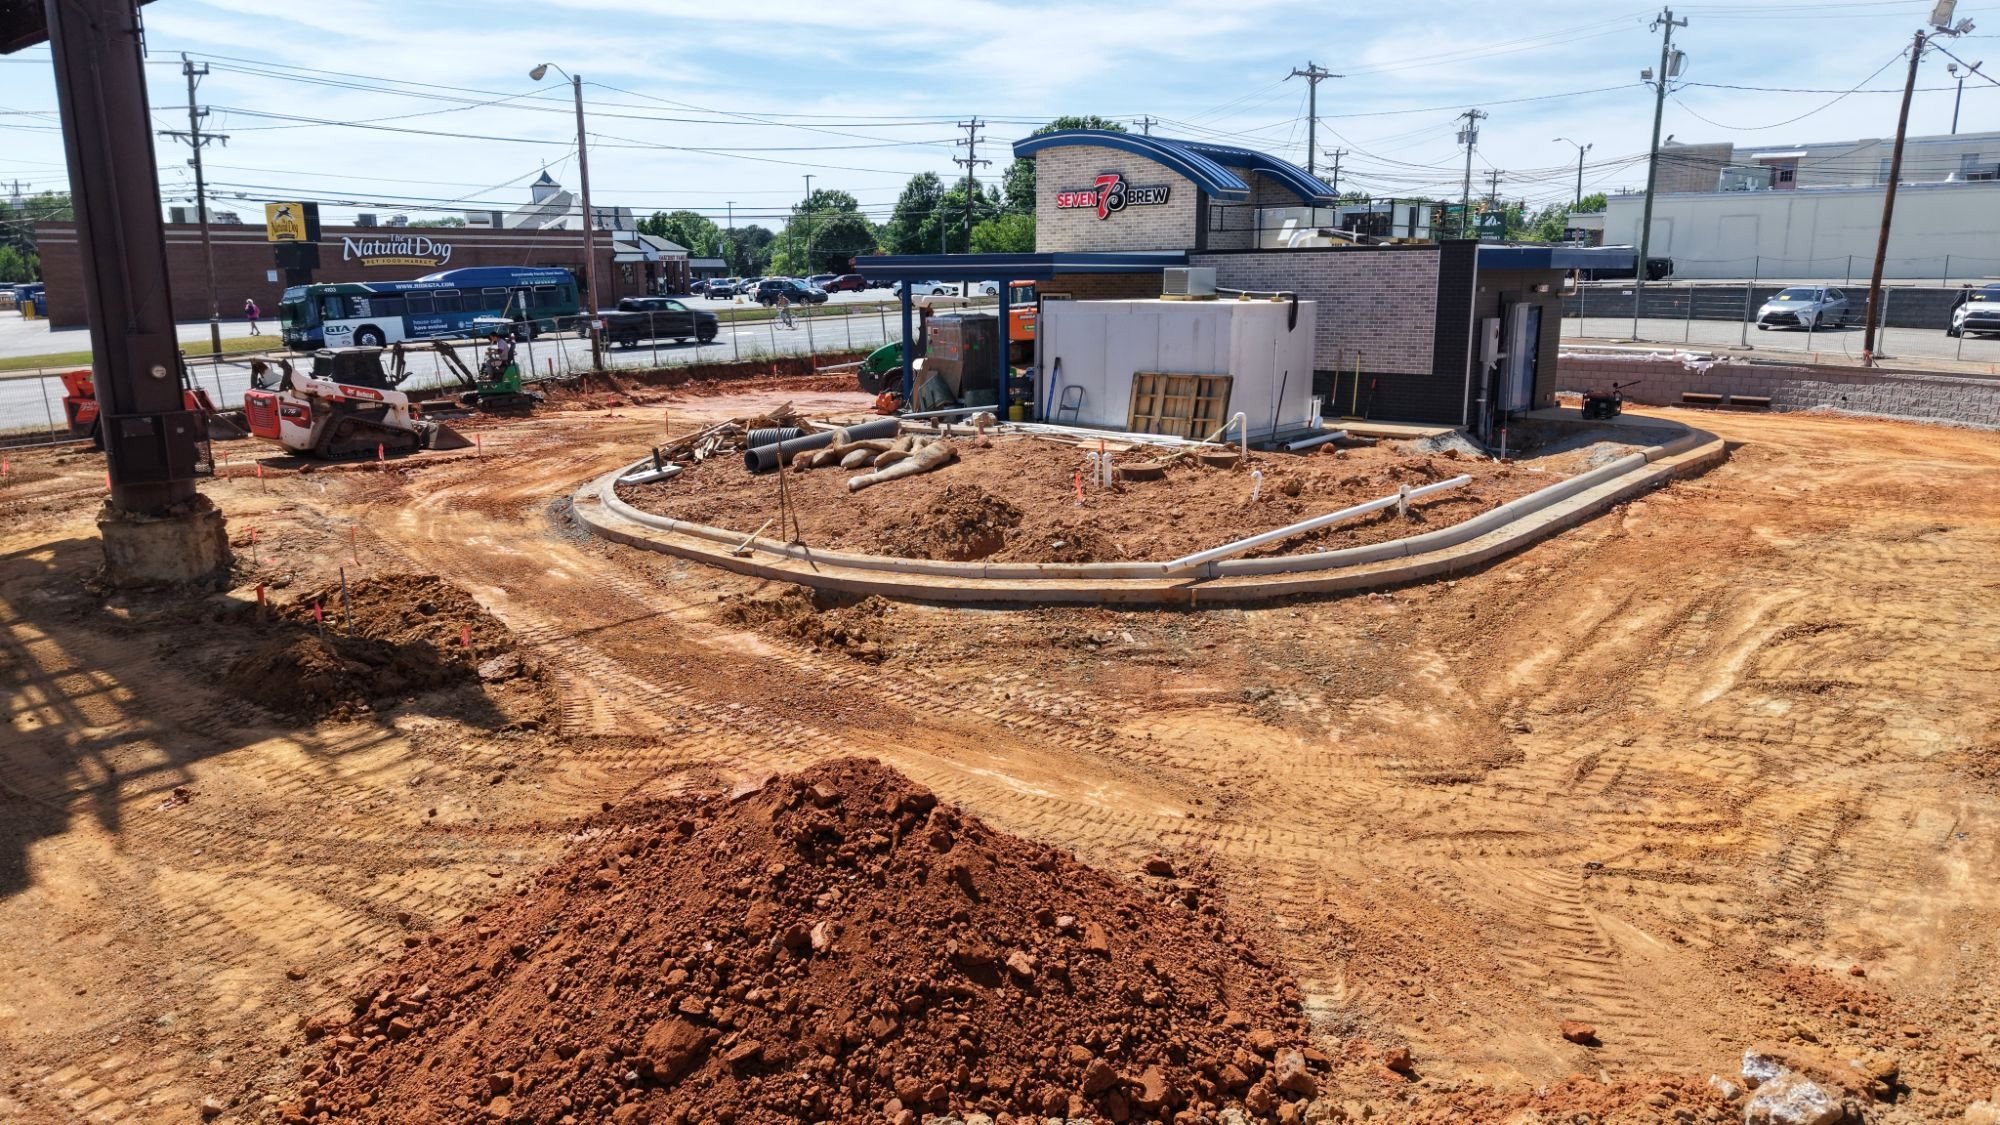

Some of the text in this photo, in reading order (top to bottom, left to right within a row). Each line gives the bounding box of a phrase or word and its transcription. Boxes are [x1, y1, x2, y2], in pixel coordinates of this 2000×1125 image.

[1056, 191, 1097, 208] SEVEN
[1127, 186, 1168, 205] BREW
[390, 234, 405, 242] The
[341, 236, 452, 266] Natural Dog
[325, 325, 353, 333] GTA
